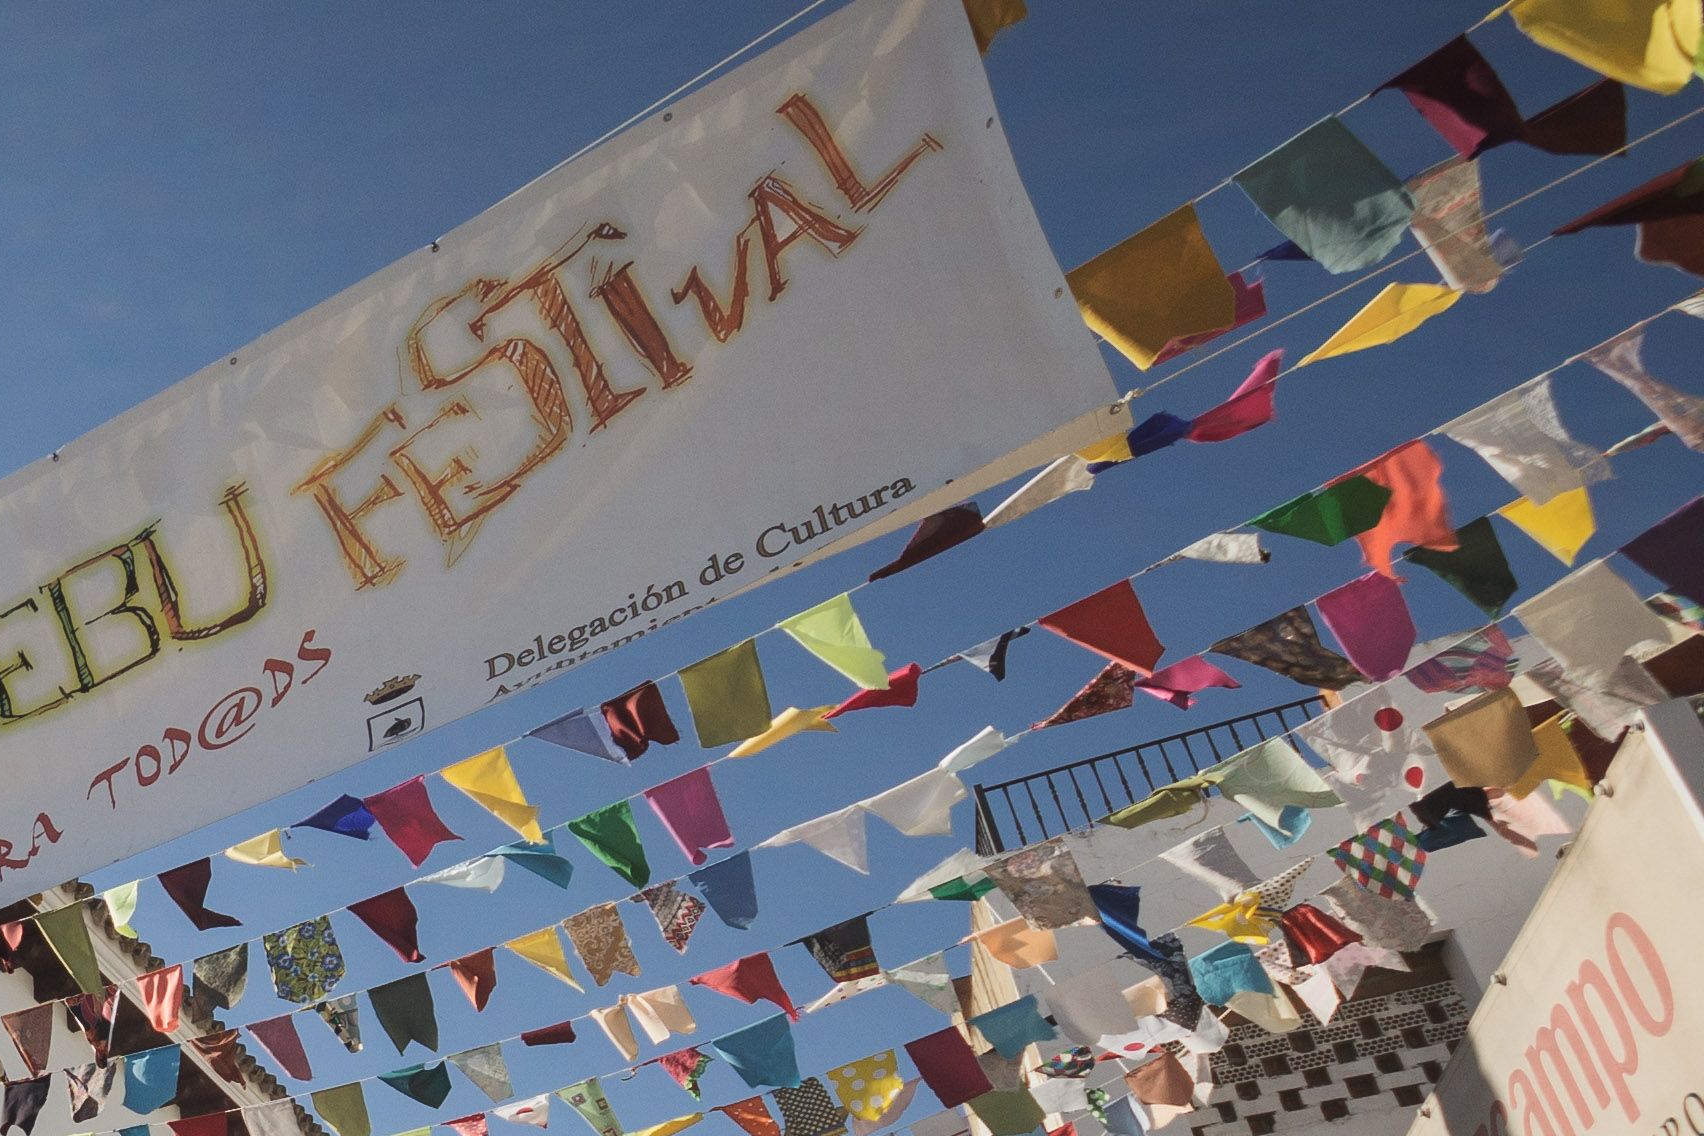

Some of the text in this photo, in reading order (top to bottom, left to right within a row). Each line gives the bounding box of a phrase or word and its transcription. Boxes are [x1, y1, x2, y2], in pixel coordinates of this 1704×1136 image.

[290, 93, 944, 591] FESTIVAL
[484, 584, 689, 681] Delegación
[698, 555, 745, 586] de
[755, 475, 917, 558] Cultura
